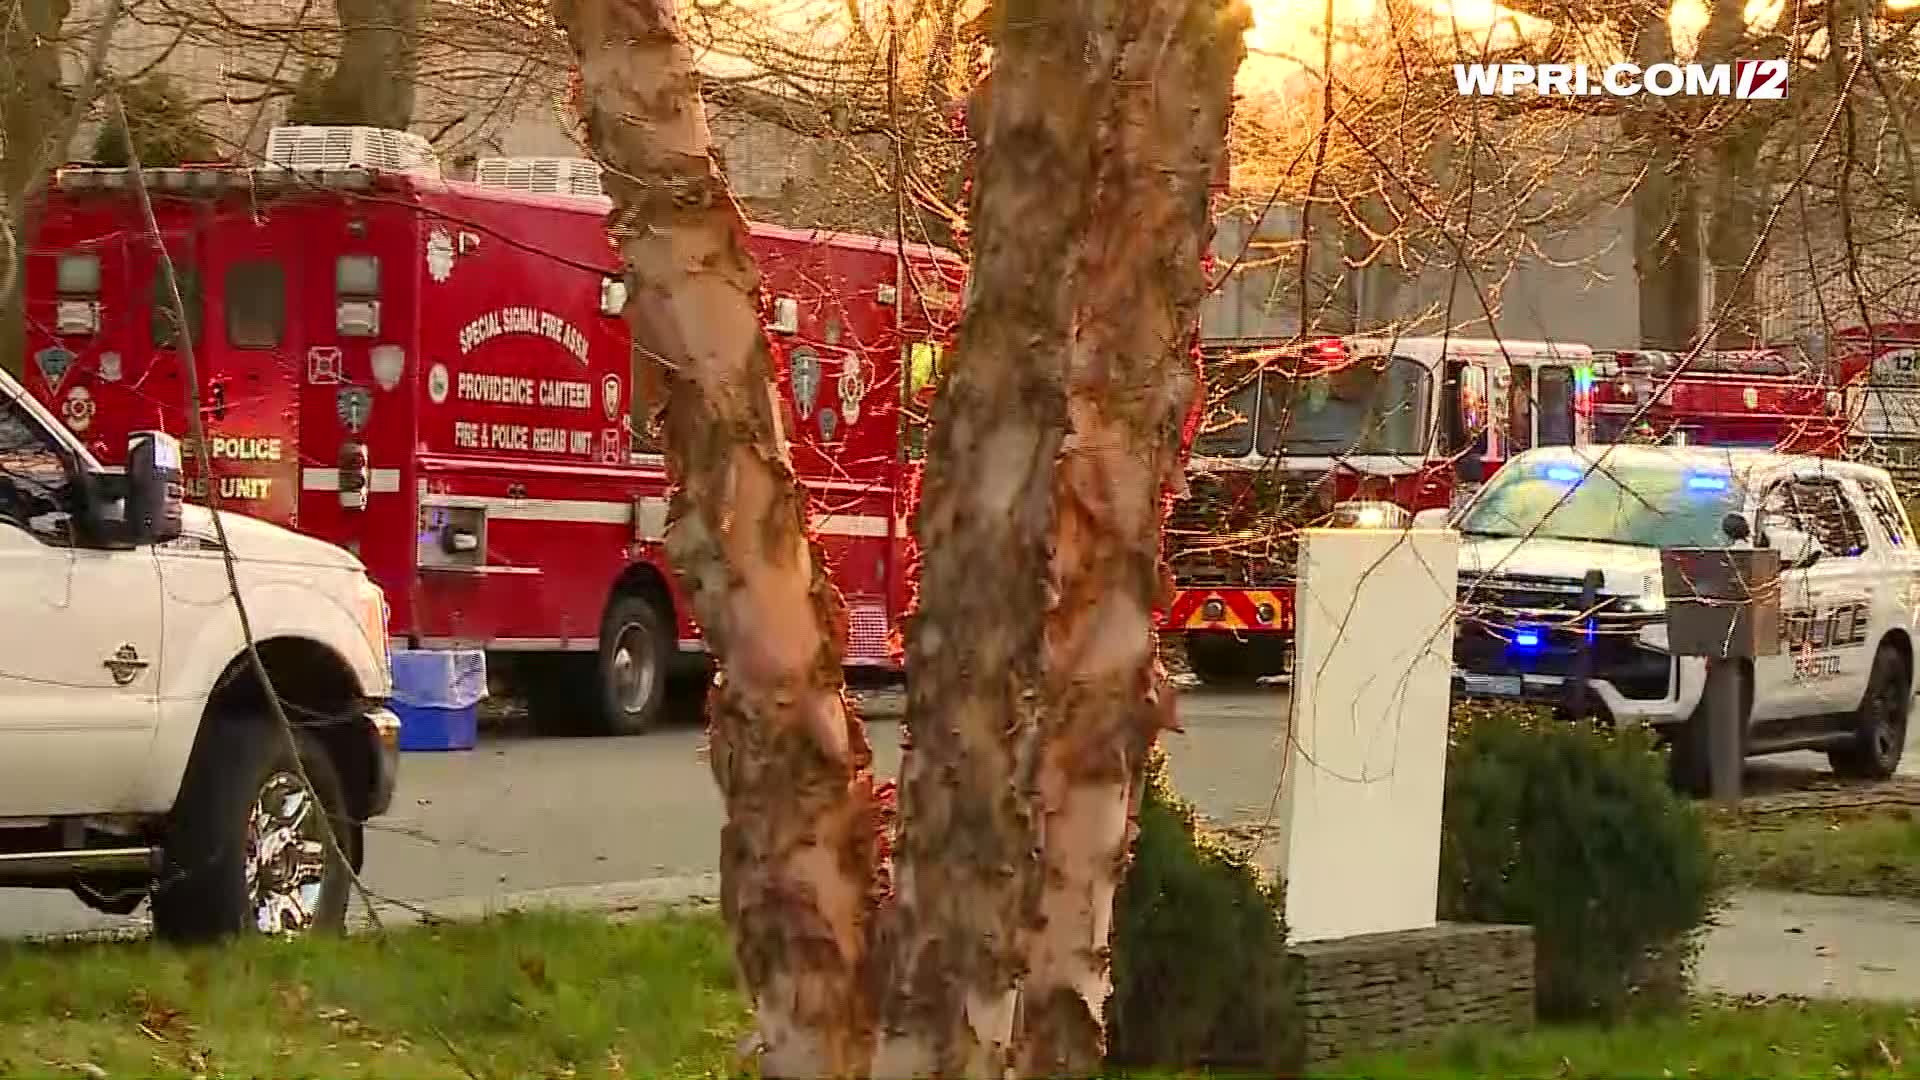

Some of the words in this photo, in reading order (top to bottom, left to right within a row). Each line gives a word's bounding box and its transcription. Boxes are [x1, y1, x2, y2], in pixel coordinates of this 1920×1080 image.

[459, 309, 503, 355] SPECIAL
[502, 306, 539, 335] SIGNAL
[540, 310, 564, 344] FIRE
[457, 371, 534, 405] PROVIDENCE
[538, 379, 592, 409] CANTEEN
[212, 437, 281, 460] POLICE
[455, 421, 478, 447] FIRE
[480, 422, 489, 449] &
[491, 424, 529, 450] POLICE
[532, 428, 567, 453] REHAB
[570, 430, 593, 455] UNIT
[220, 477, 273, 499] UNIT
